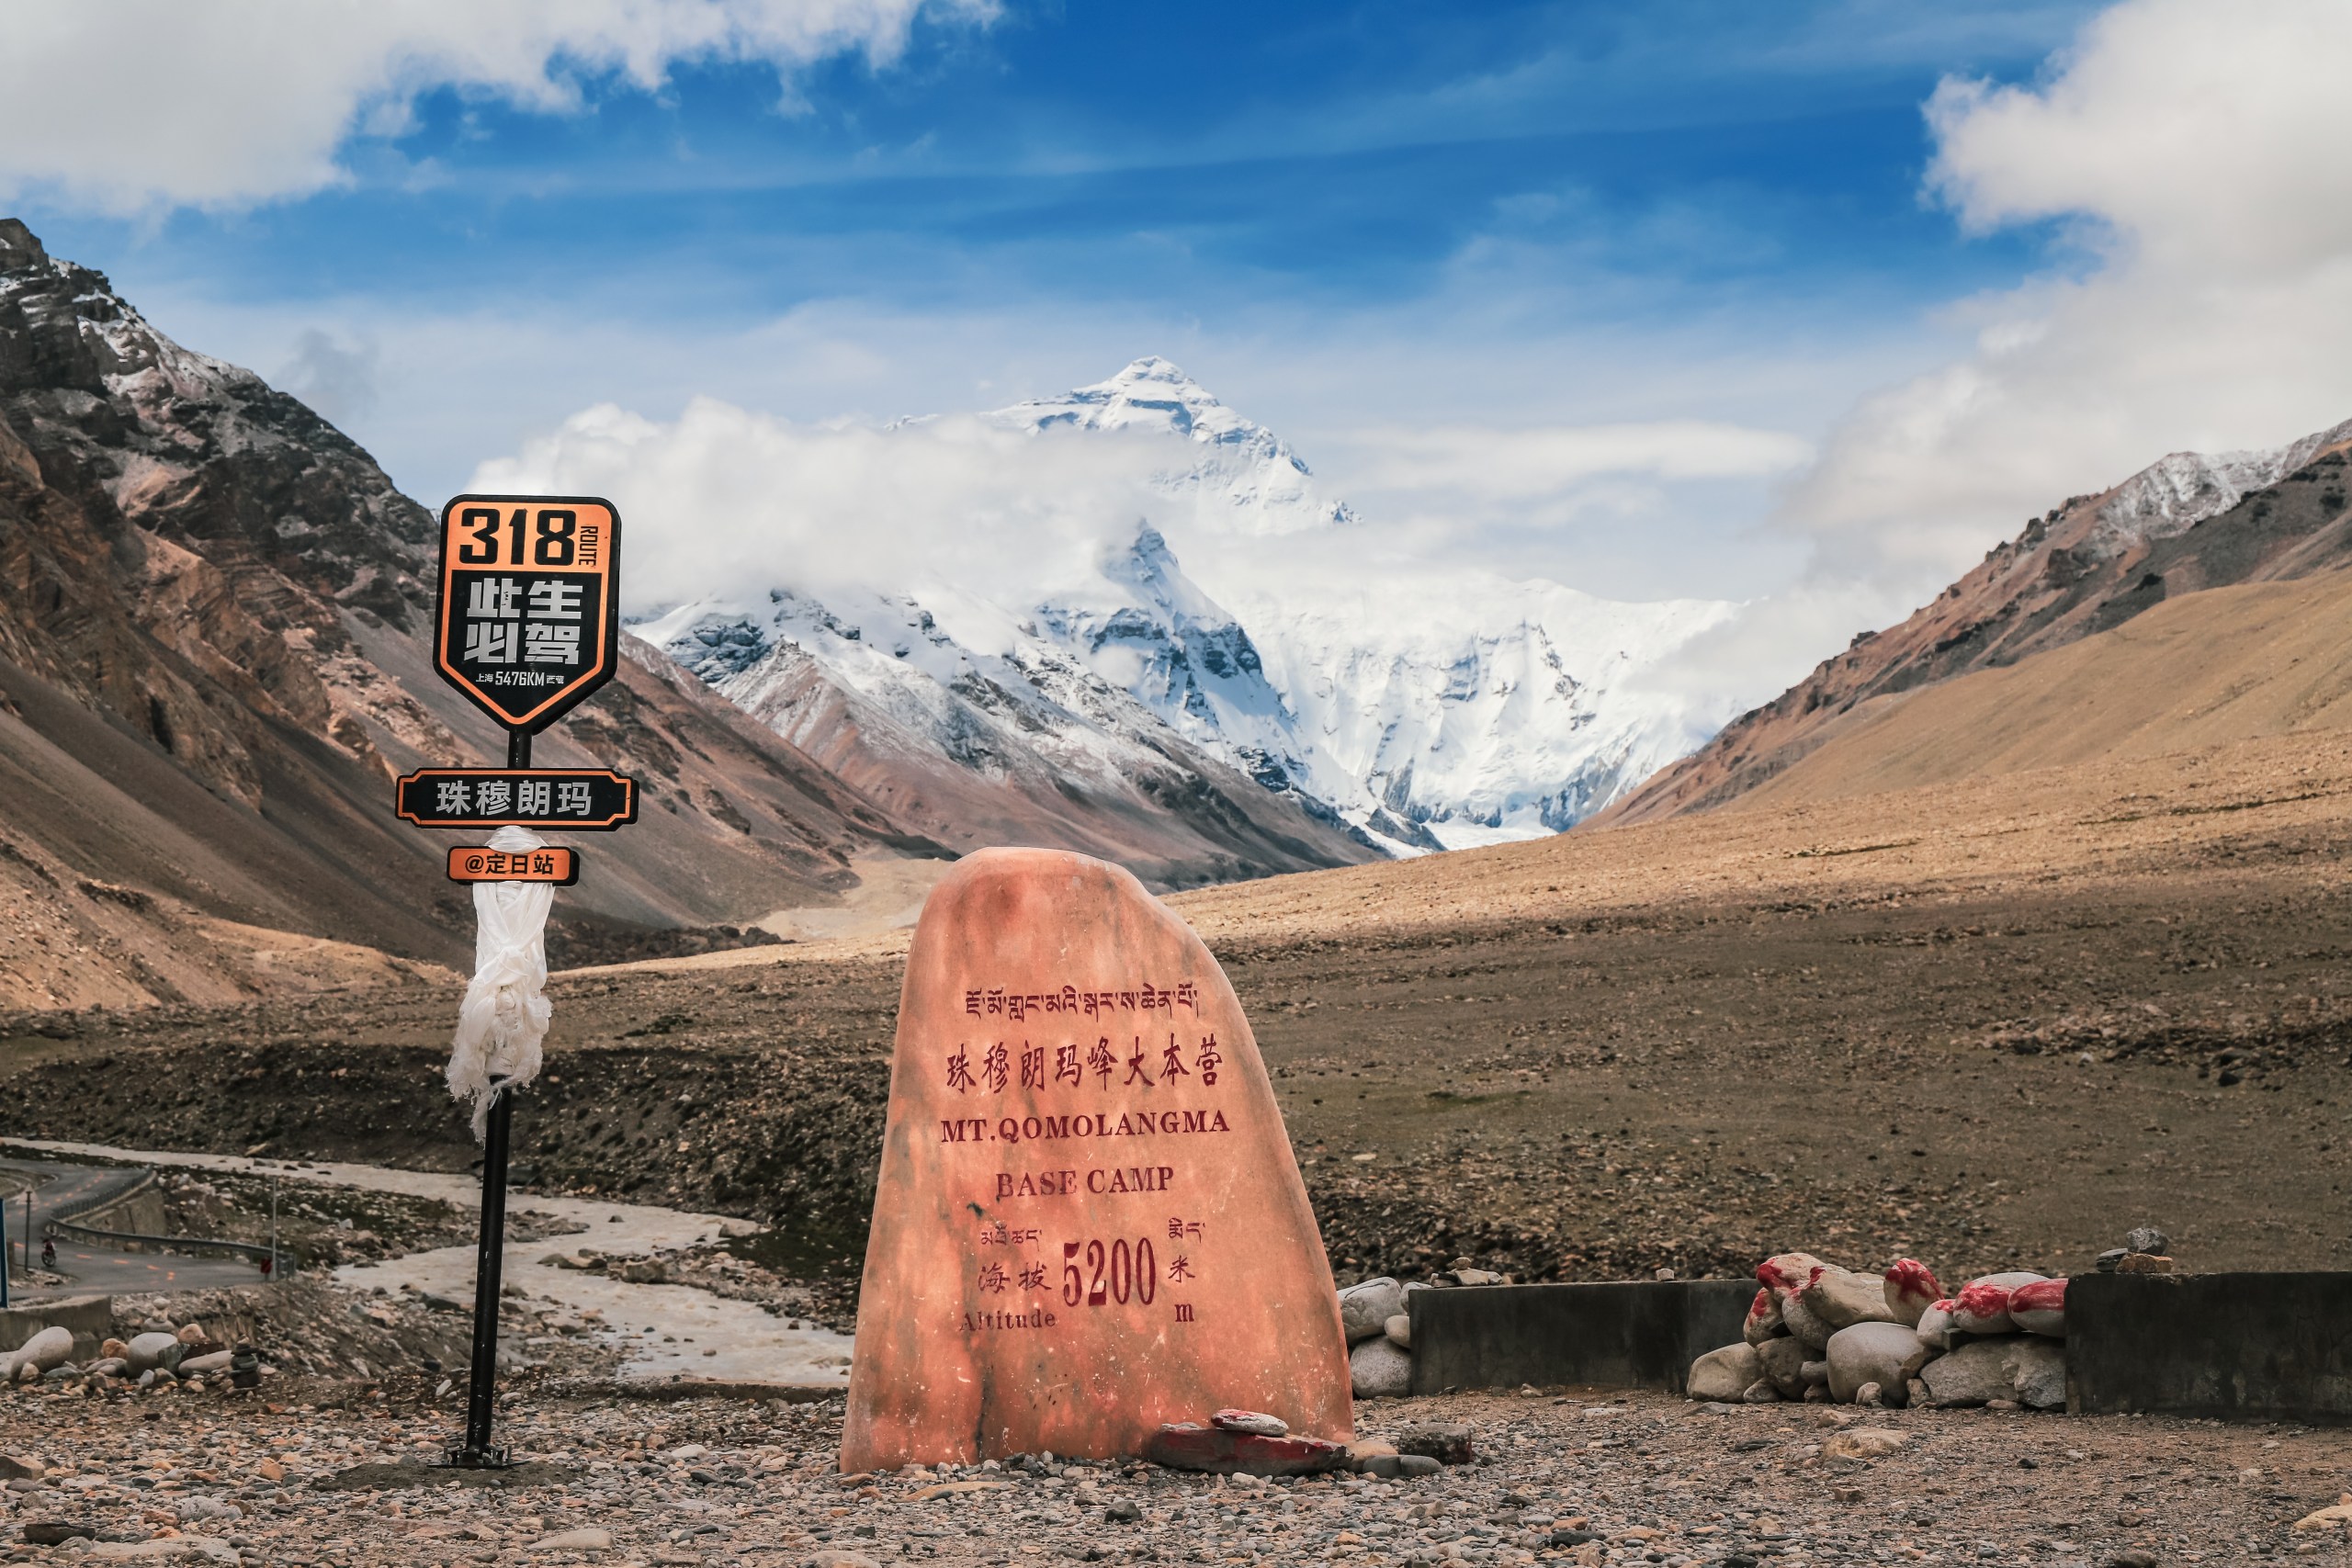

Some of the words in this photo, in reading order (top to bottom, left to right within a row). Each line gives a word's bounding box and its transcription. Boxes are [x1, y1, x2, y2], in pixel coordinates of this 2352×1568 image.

[459, 508, 577, 566] 318
[578, 525, 599, 567] ROUTE
[467, 578, 583, 619] 此生
[464, 622, 581, 664] 必驾
[476, 672, 493, 683] 上海
[495, 671, 545, 686] 5476KM
[435, 780, 593, 816] 珠穆朗玛
[465, 854, 554, 875] @定日站
[946, 1032, 1223, 1094] 珠穆朗玛峰大本营
[996, 1170, 1077, 1198] BASE
[1087, 1167, 1174, 1194] CAMP
[978, 1263, 1052, 1294] 海拔
[1063, 1237, 1157, 1307] 5200
[1169, 1255, 1195, 1283] 米
[959, 1309, 1057, 1331] Altitude
[1175, 1302, 1194, 1322] m
